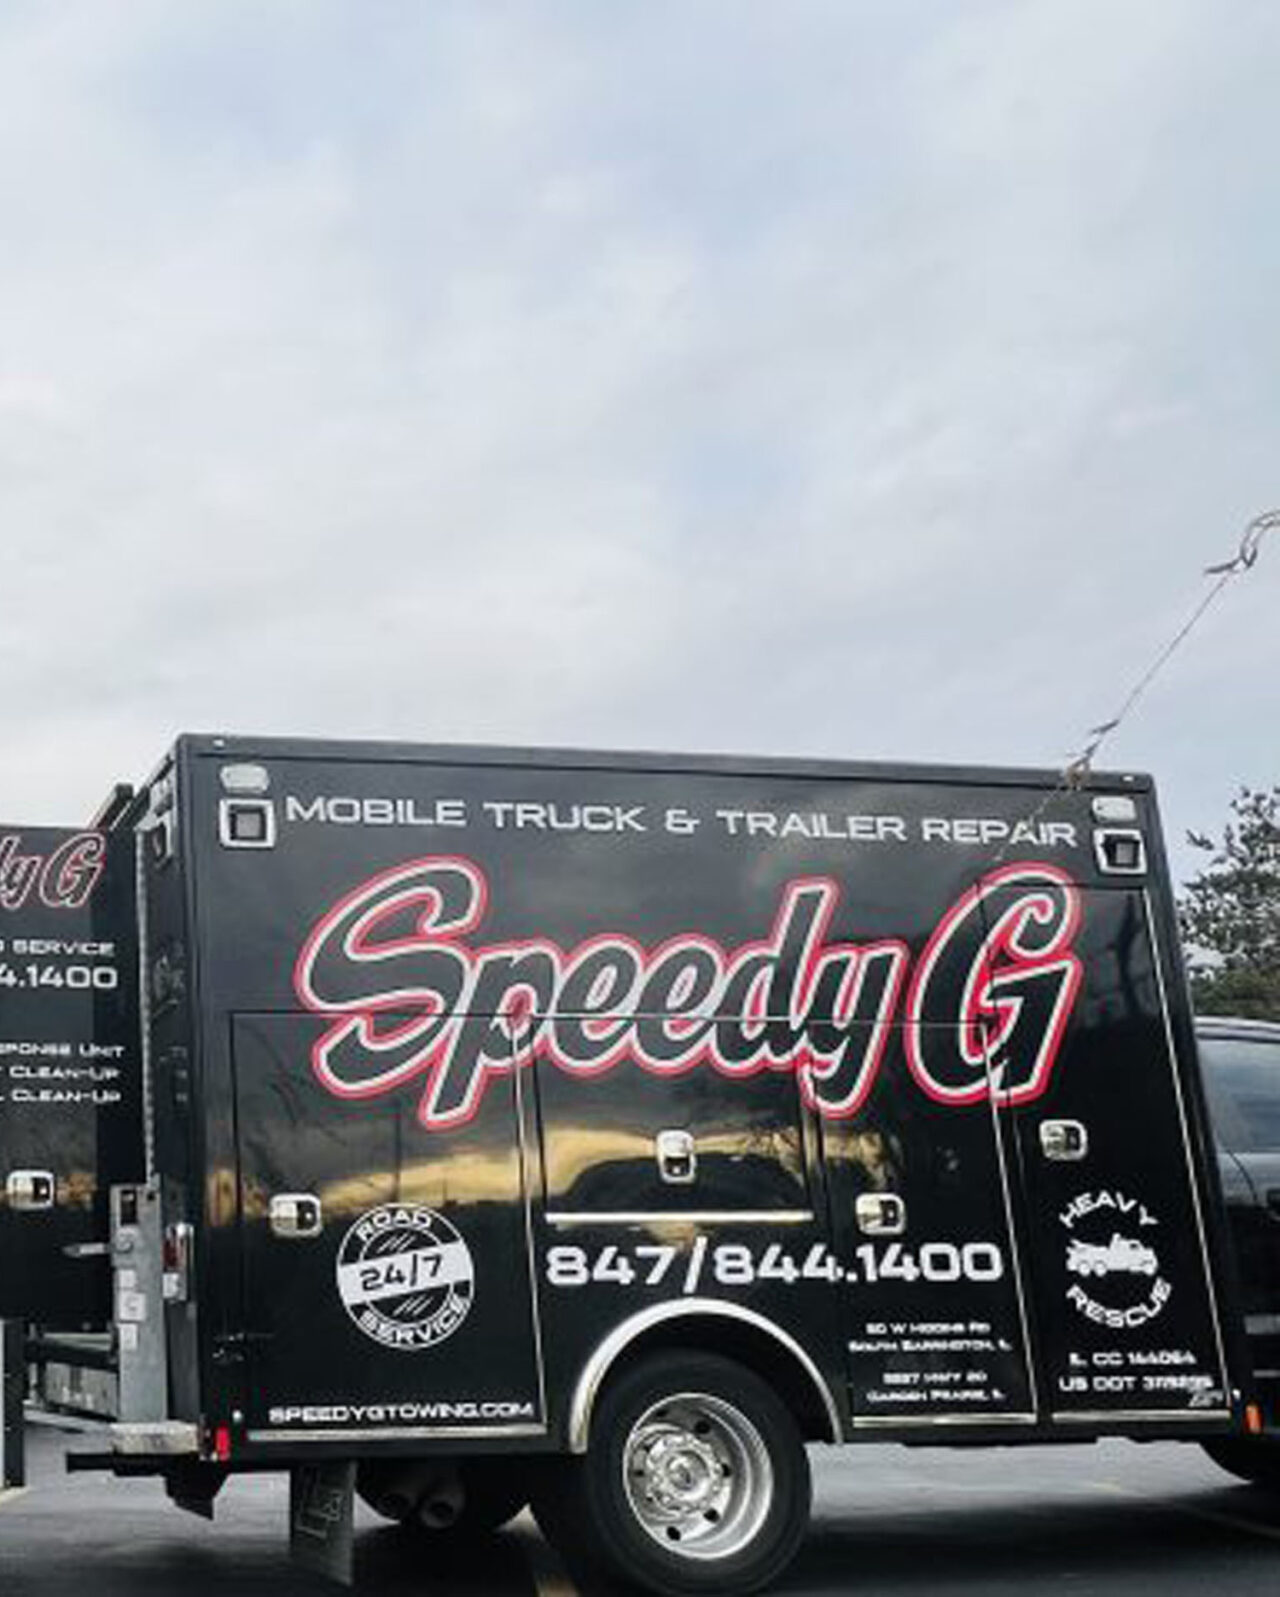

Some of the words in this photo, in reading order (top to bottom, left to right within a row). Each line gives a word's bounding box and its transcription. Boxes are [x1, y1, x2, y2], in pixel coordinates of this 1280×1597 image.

[287, 796, 466, 826] MOBILE
[483, 802, 646, 832] TRUCK
[665, 809, 700, 834] &
[716, 810, 907, 841] TRAILER
[922, 818, 1078, 848] REPAIR
[39, 831, 106, 908] G
[13, 939, 115, 957] SERVICE
[294, 857, 909, 1130] Speedy
[906, 860, 1082, 1107] G
[79, 1043, 125, 1057] UNIT
[9, 1065, 120, 1080] CLEAN-UP
[12, 1089, 121, 1103] CLEAN-UP
[356, 1209, 432, 1241] ROAD
[1059, 1190, 1159, 1228] HEAVY
[359, 1253, 443, 1292] 24/7
[546, 1236, 1004, 1294] 847/844.1400
[359, 1294, 464, 1344] SERVICE
[1066, 1277, 1171, 1328] RESCUE
[1058, 1375, 1089, 1392] US
[1092, 1376, 1137, 1392] DOT
[269, 1402, 534, 1424] SPEEDYGTOWING.COM
